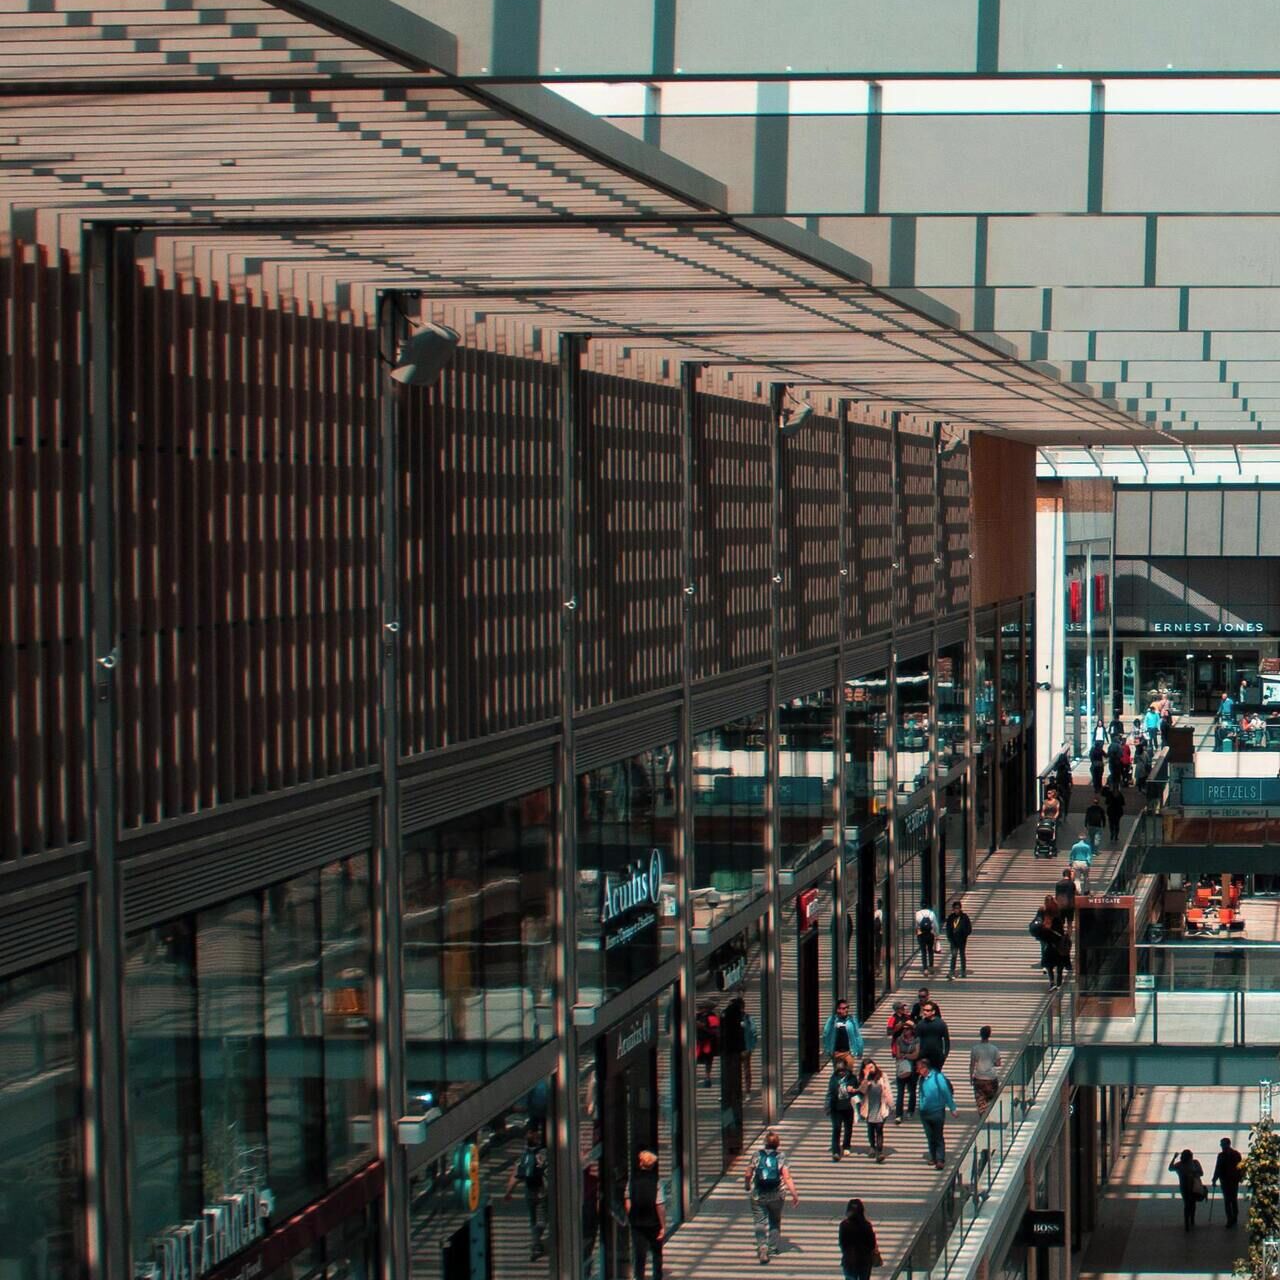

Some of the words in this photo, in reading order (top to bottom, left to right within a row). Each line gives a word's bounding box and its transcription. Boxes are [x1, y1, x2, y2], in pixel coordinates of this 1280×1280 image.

[1154, 623, 1210, 632] ERNEST
[1217, 623, 1264, 632] JONES
[1208, 785, 1257, 799] PRETZELS
[601, 859, 648, 923] Acuitis
[1033, 1223, 1060, 1232] BOSS
